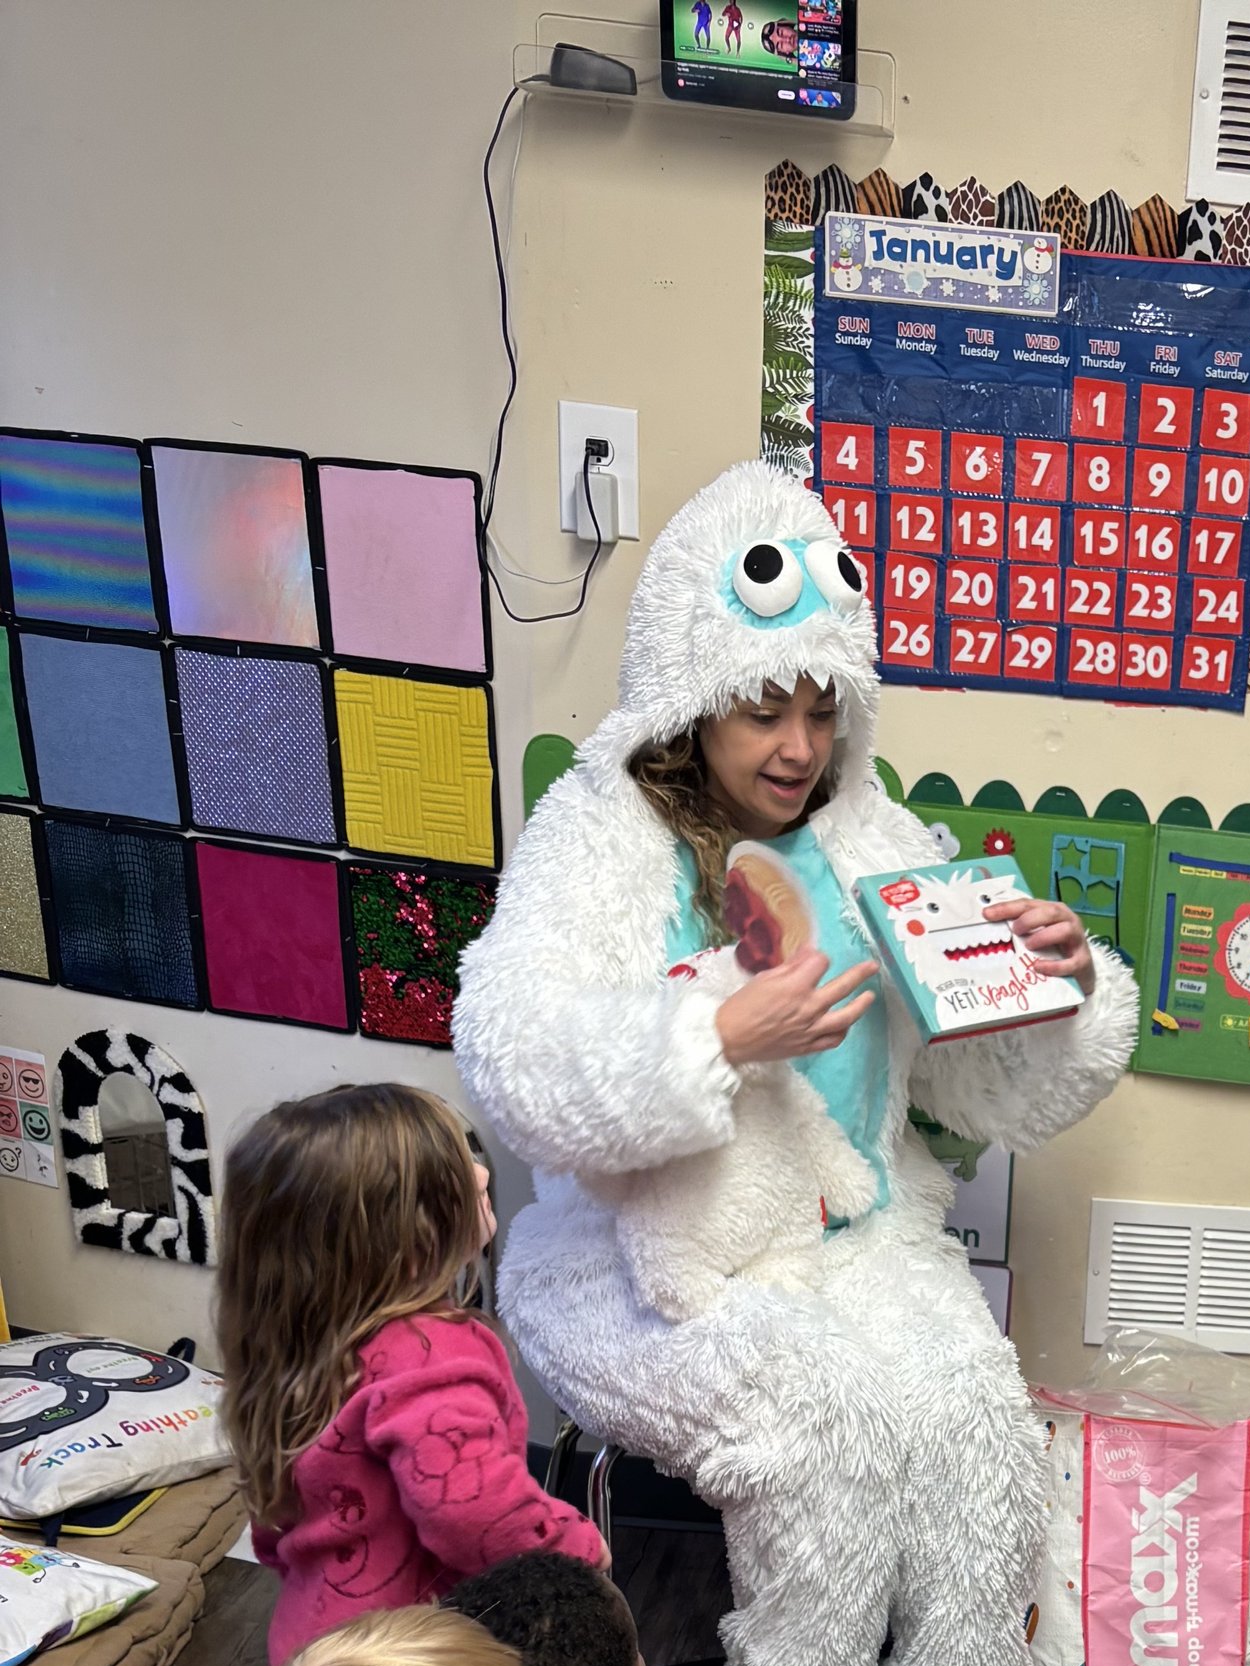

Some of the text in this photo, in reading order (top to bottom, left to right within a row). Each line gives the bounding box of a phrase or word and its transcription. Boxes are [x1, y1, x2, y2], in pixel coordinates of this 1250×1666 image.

[868, 228, 1019, 281] January
[835, 331, 1249, 383] Sunday Monday Tuesday Wednesday Thursday Friday Saturday
[838, 317, 1242, 367] SUN MON TUE WED THU FRI SAT
[1093, 392, 1238, 439] 1 2 3
[836, 436, 1244, 504] 4 5 6 7 8 9 10
[833, 500, 1234, 564] 11 12 13 14 15 16 17
[891, 563, 930, 599] 19
[951, 570, 994, 606] 20
[1016, 575, 1055, 609] 21
[1070, 580, 1112, 615] 22
[1129, 584, 1172, 620] 23
[1198, 589, 1239, 624] 24
[889, 621, 1227, 681] 26 27 29 28 30 31
[945, 989, 979, 1014] YETI
[1179, 983, 1202, 992] Friday
[39, 1405, 214, 1470] eathing Track
[1103, 1446, 1138, 1464] 100%
